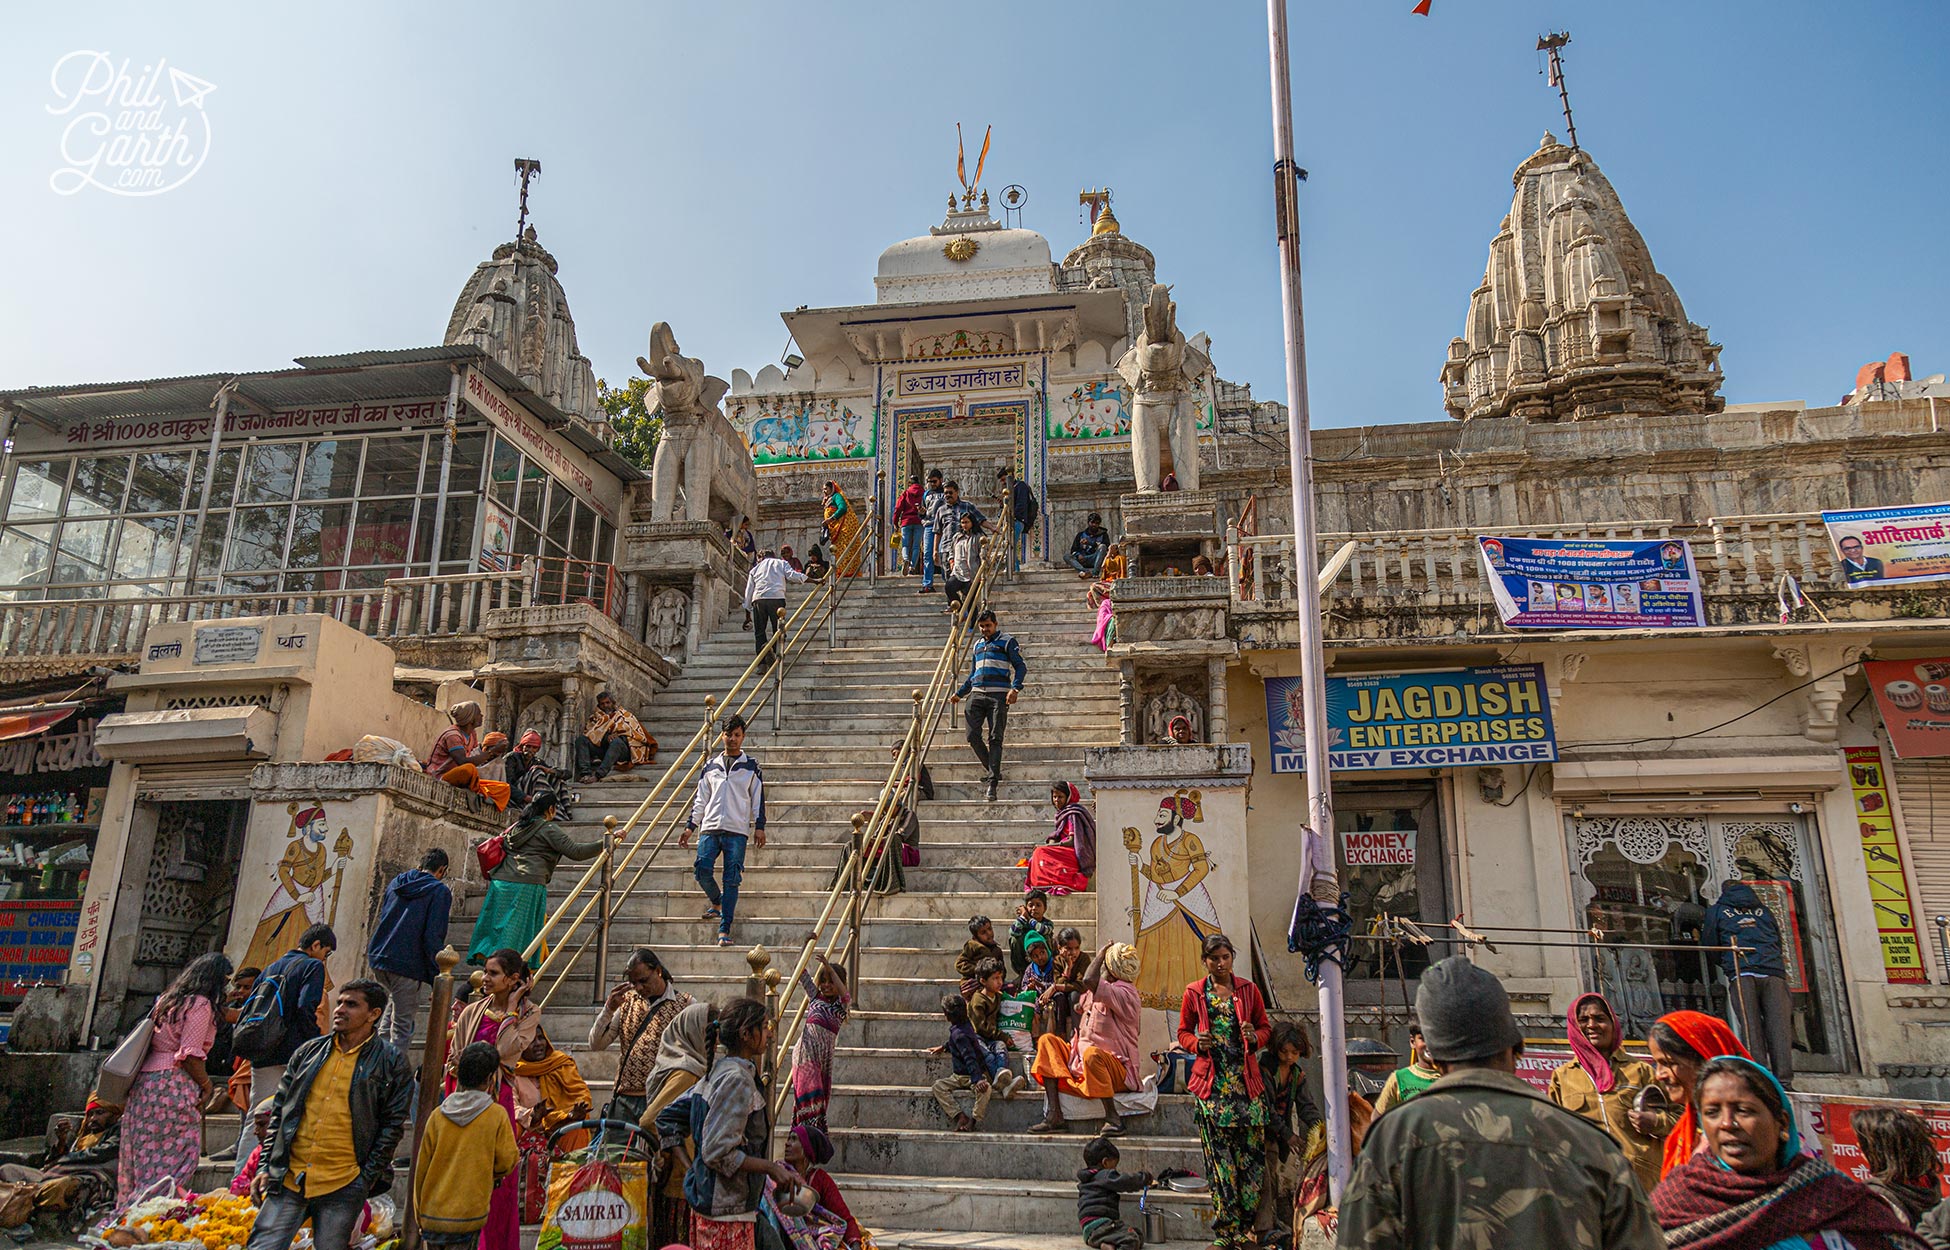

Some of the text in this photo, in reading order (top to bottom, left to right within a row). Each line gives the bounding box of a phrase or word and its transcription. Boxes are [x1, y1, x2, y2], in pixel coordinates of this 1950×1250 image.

[920, 375, 948, 390] जय
[949, 369, 1001, 388] जगदीश
[1003, 366, 1020, 384] हरे
[67, 421, 91, 443] श्री
[92, 420, 115, 442] श्री
[116, 422, 159, 440] 1008
[161, 417, 211, 441] ठाकुर
[313, 408, 340, 427] राय
[341, 402, 363, 423] जी
[363, 404, 390, 422] का
[392, 401, 437, 420] रजत
[1862, 522, 1945, 545] आदित्यार्क
[1347, 681, 1541, 722] JAGDISH
[1349, 718, 1546, 748] ENTERPRISES
[1281, 744, 1549, 770] MNEY EXCHANGE
[1346, 833, 1408, 849] MONEY
[1346, 849, 1414, 863] EXCHANGE
[28, 912, 79, 927] CHINESE
[562, 1205, 625, 1221] SAMRAT
